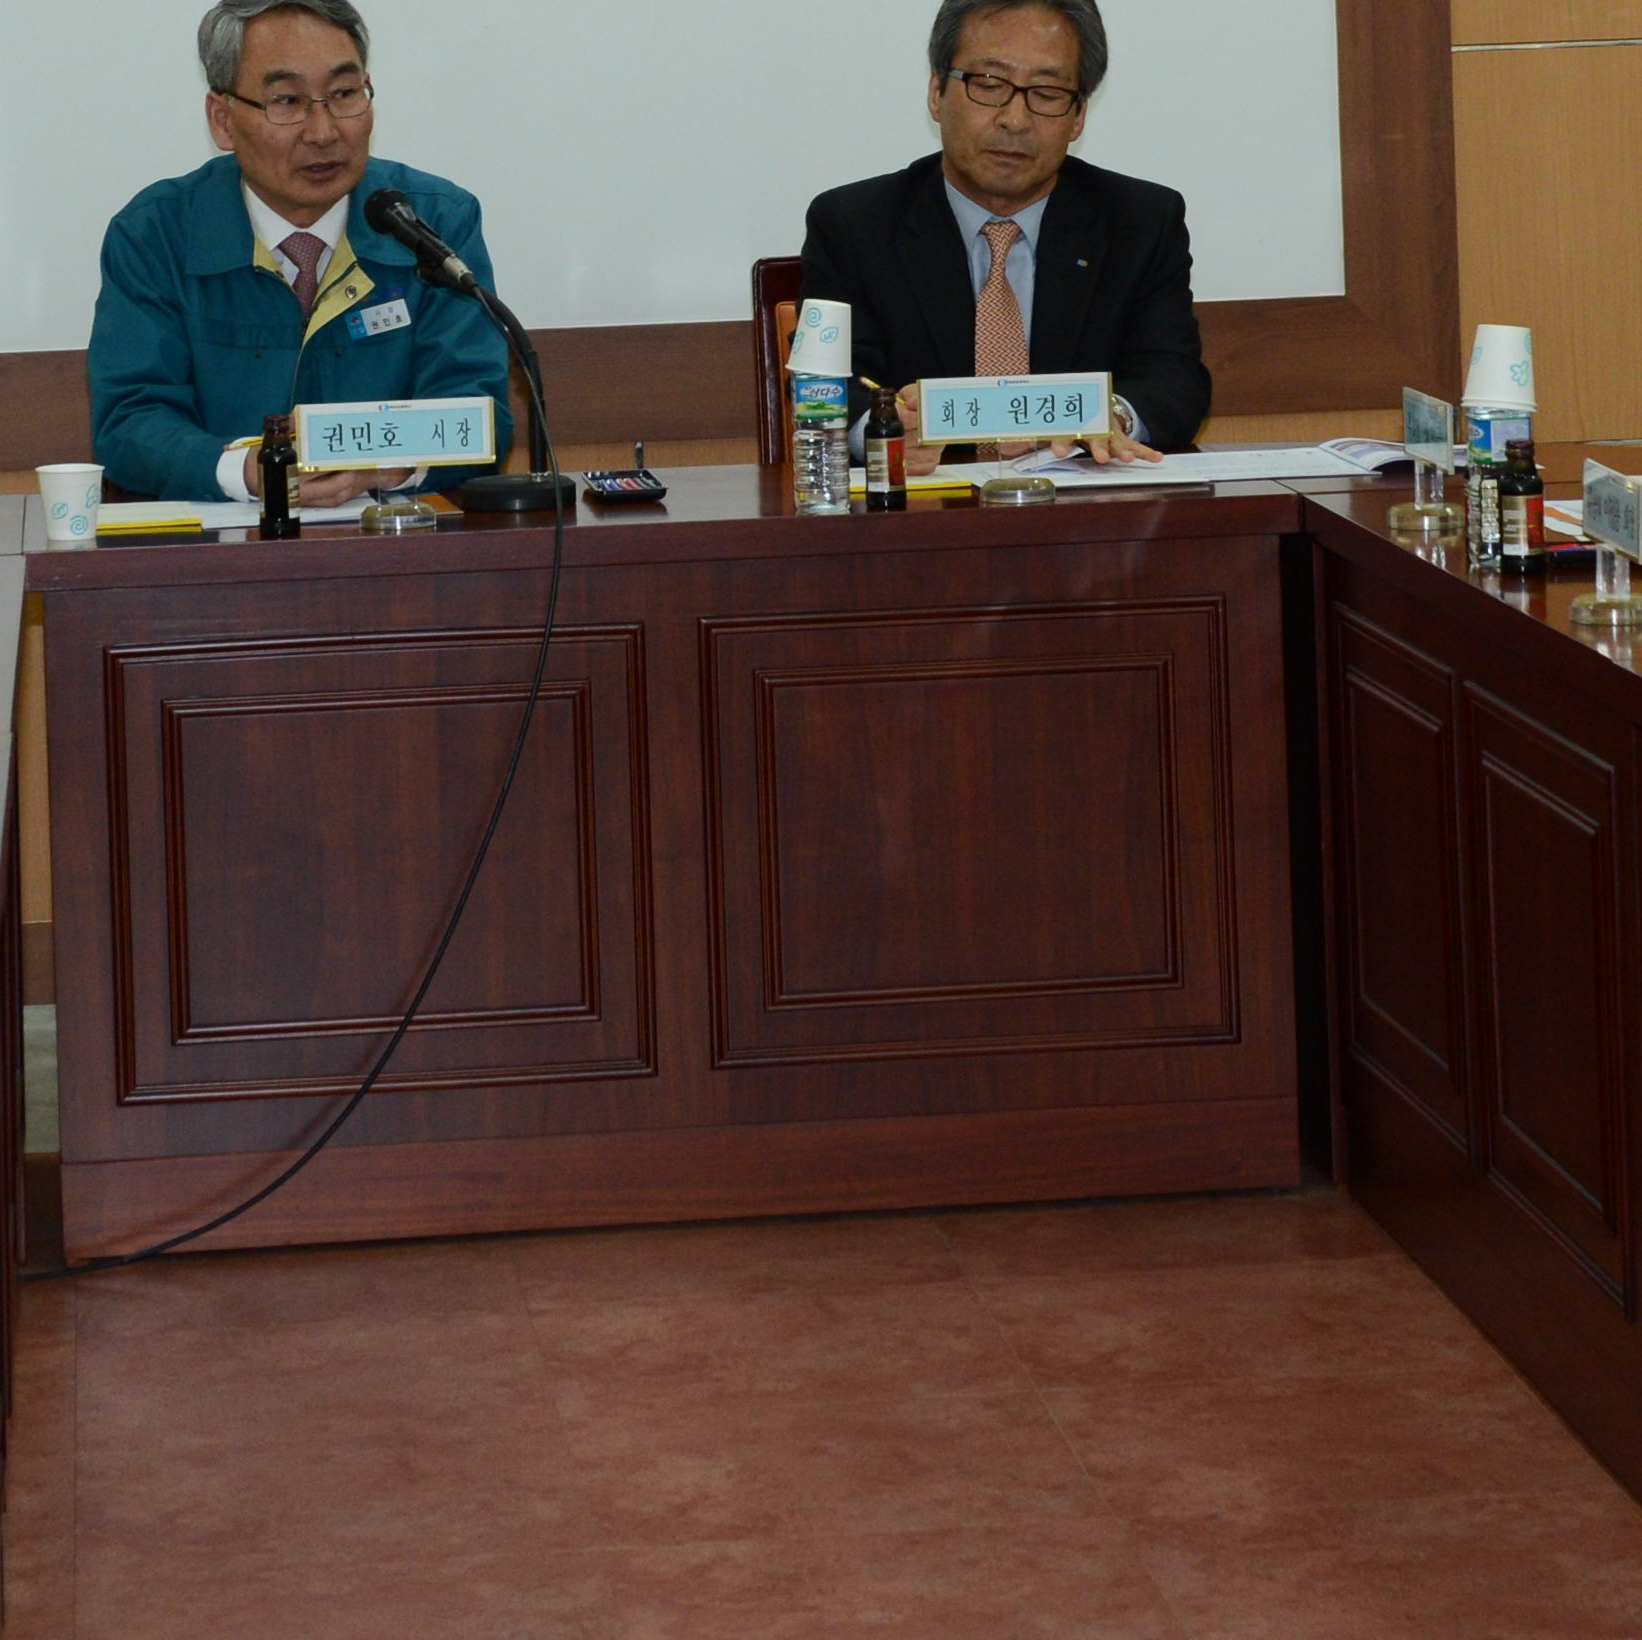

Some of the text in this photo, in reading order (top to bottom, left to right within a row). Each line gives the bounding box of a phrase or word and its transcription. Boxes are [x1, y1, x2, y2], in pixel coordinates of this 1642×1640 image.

[941, 392, 1084, 428] 회장 원경희
[322, 417, 472, 453] 권민호 시장
